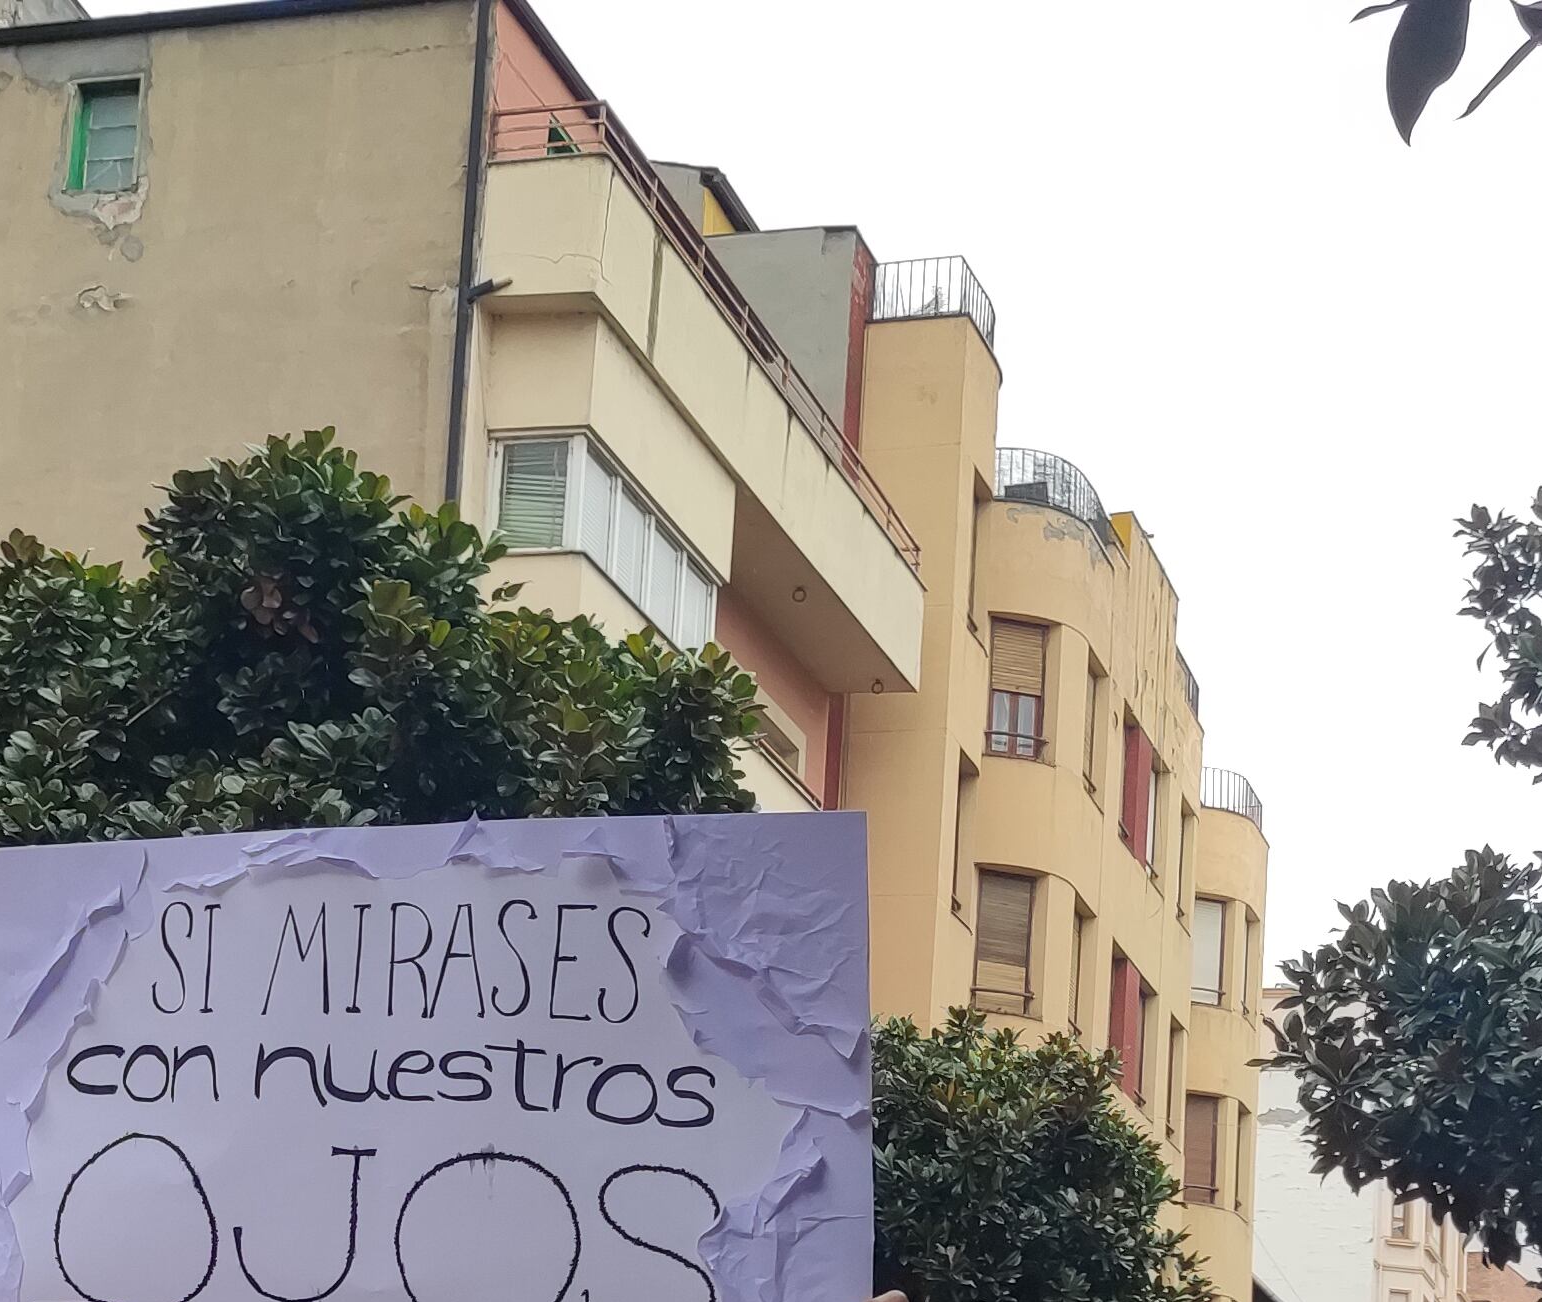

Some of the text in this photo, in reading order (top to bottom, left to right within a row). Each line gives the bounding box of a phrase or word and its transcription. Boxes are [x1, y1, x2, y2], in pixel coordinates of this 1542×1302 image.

[151, 898, 651, 1024] SI MIRASES
[67, 1038, 716, 1129] con nuestros
